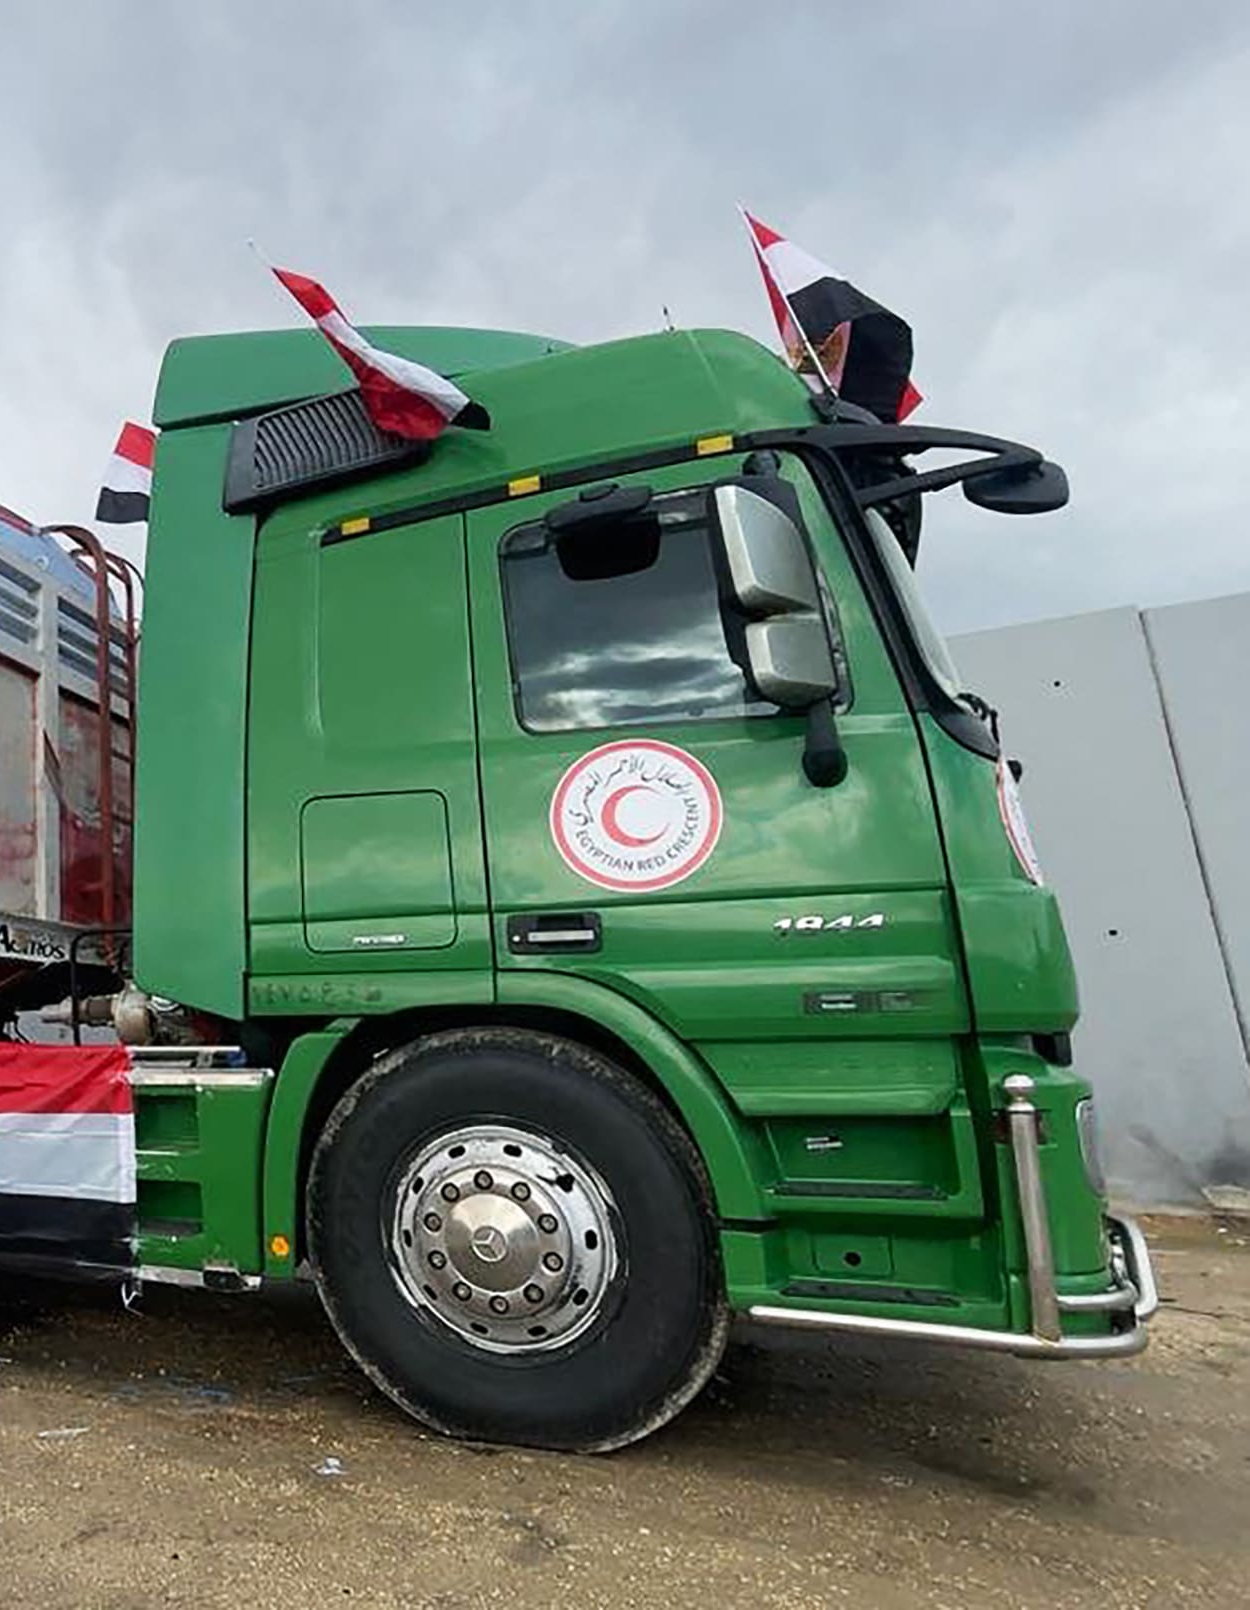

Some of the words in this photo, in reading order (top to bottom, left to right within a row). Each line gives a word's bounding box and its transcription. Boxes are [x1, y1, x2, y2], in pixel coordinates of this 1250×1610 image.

[575, 830, 634, 871] EGYPTIAN
[637, 854, 667, 871] RED
[664, 797, 700, 860] CRESCENT
[772, 914, 884, 931] 1844
